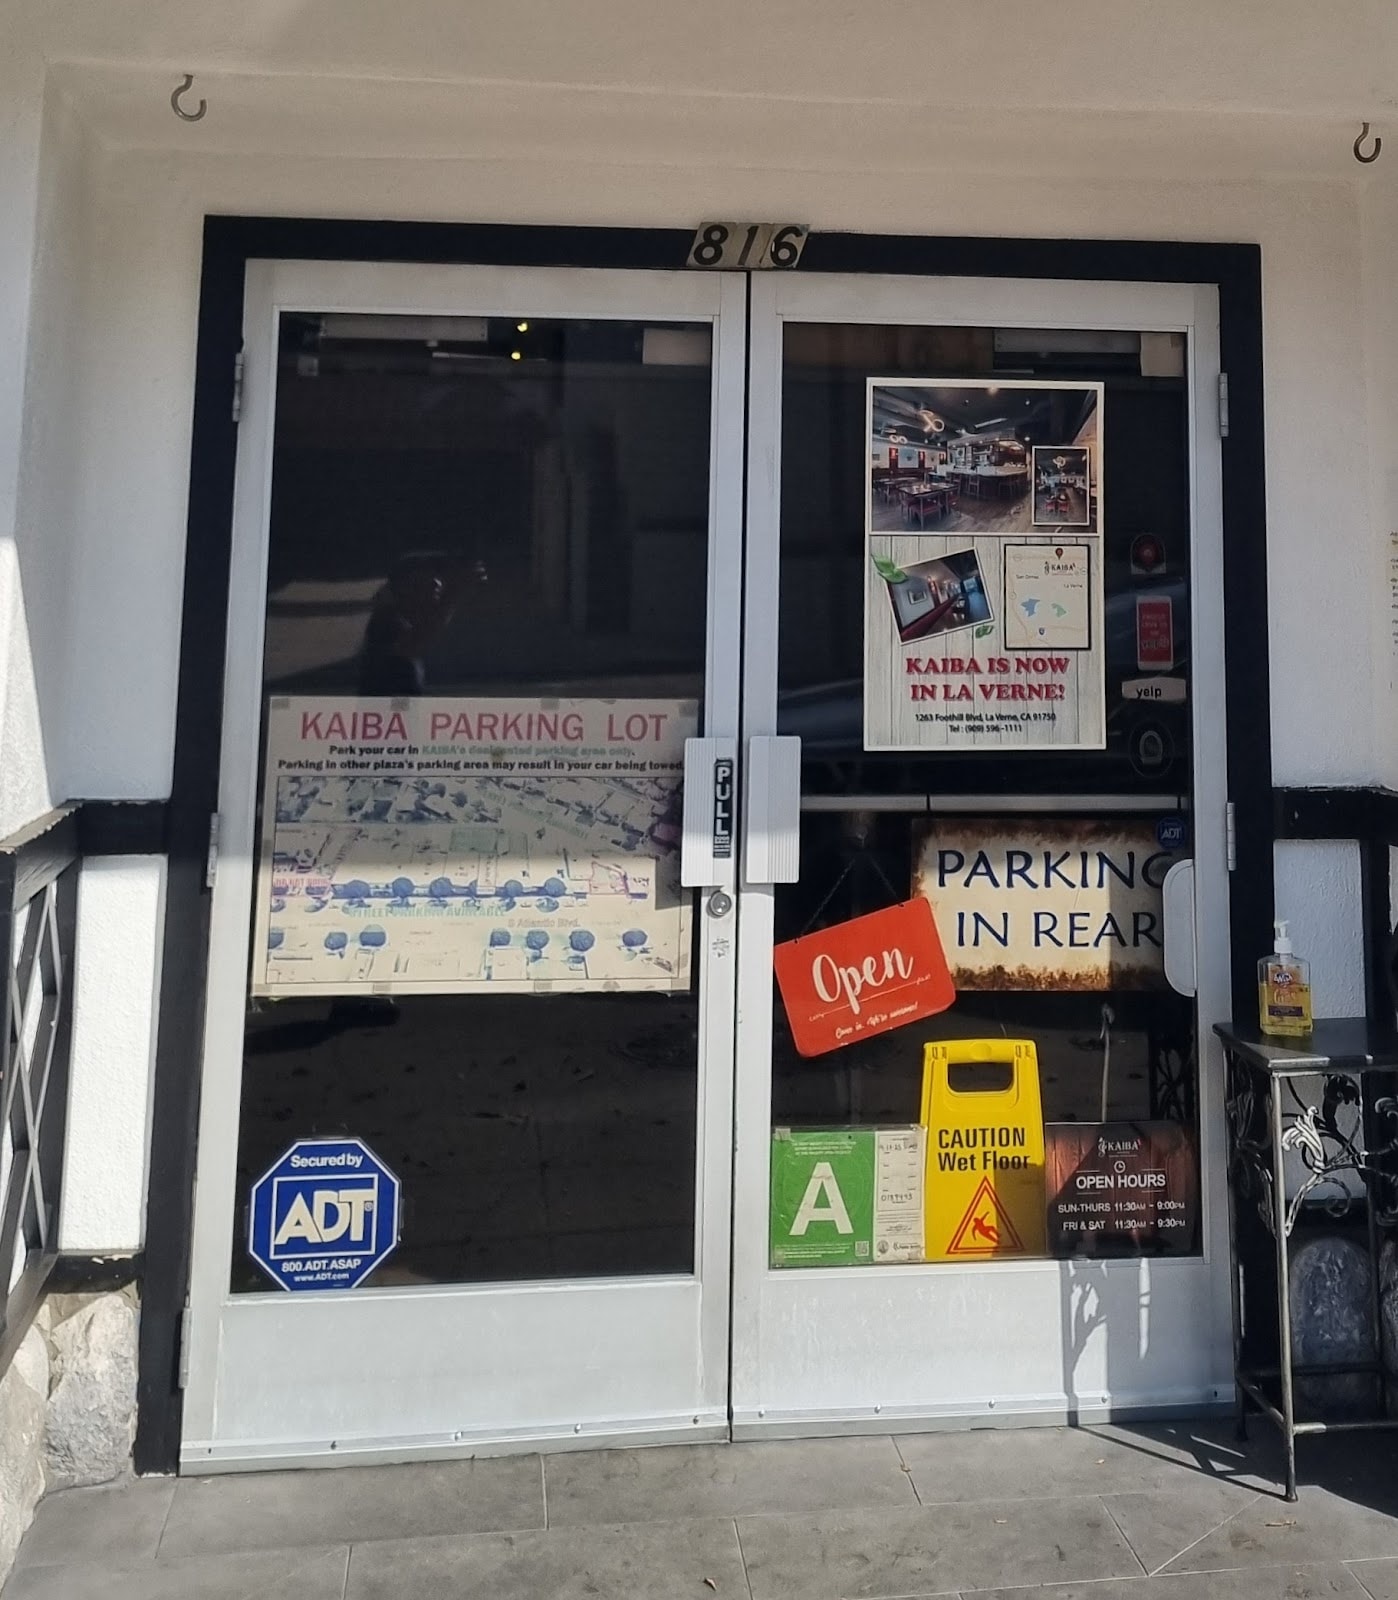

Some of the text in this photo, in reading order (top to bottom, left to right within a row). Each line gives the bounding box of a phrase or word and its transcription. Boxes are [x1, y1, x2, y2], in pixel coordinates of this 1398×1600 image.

[693, 224, 803, 267] 816
[906, 657, 1070, 674] KAIBA IS NOW
[910, 684, 1065, 701] IN LA VERNE!
[1136, 685, 1162, 699] yelp
[915, 713, 933, 721] 1263
[935, 713, 963, 721] Foothill
[985, 713, 994, 721] La
[1020, 713, 1032, 721] CA
[300, 711, 668, 742] KAIBA PARKING LOT
[965, 724, 984, 733] (909)
[329, 745, 356, 755] Park
[358, 746, 385, 757] your
[387, 746, 406, 755] car
[408, 745, 419, 755] in
[278, 760, 323, 771] Parking
[326, 760, 337, 769] in
[340, 760, 370, 769] other
[373, 760, 414, 771] plaza's
[417, 760, 460, 771] parking
[464, 761, 489, 770] area
[493, 761, 515, 771] may
[518, 760, 551, 770] result
[554, 760, 564, 770] in
[568, 762, 592, 771] your
[595, 761, 612, 770] car
[615, 760, 646, 771] being
[715, 766, 731, 836] PULL
[1160, 827, 1182, 840] ADT
[957, 911, 1162, 948] IN REAR
[812, 948, 914, 1015] Open
[938, 1127, 1026, 1149] CAUTION
[1107, 1141, 1139, 1151] KAIBA
[290, 1153, 363, 1168] Secured by
[938, 1150, 1030, 1172] Wet Floor
[1076, 1173, 1166, 1190] OPEN HOURS
[789, 1162, 854, 1236] A
[1058, 1202, 1111, 1213] SUN-THURS
[1114, 1201, 1146, 1212] 11:30AM
[1157, 1200, 1185, 1210] 9:00PM
[274, 1188, 375, 1245] ADT
[1063, 1221, 1077, 1231] FRI
[1080, 1220, 1087, 1230] &
[1089, 1220, 1106, 1231] SAT
[1115, 1219, 1146, 1229] 11:30AM
[1157, 1218, 1185, 1228] 9:30PM
[281, 1258, 361, 1273] 800.ADT.ASAP
[293, 1272, 350, 1283] www.ADT.com
